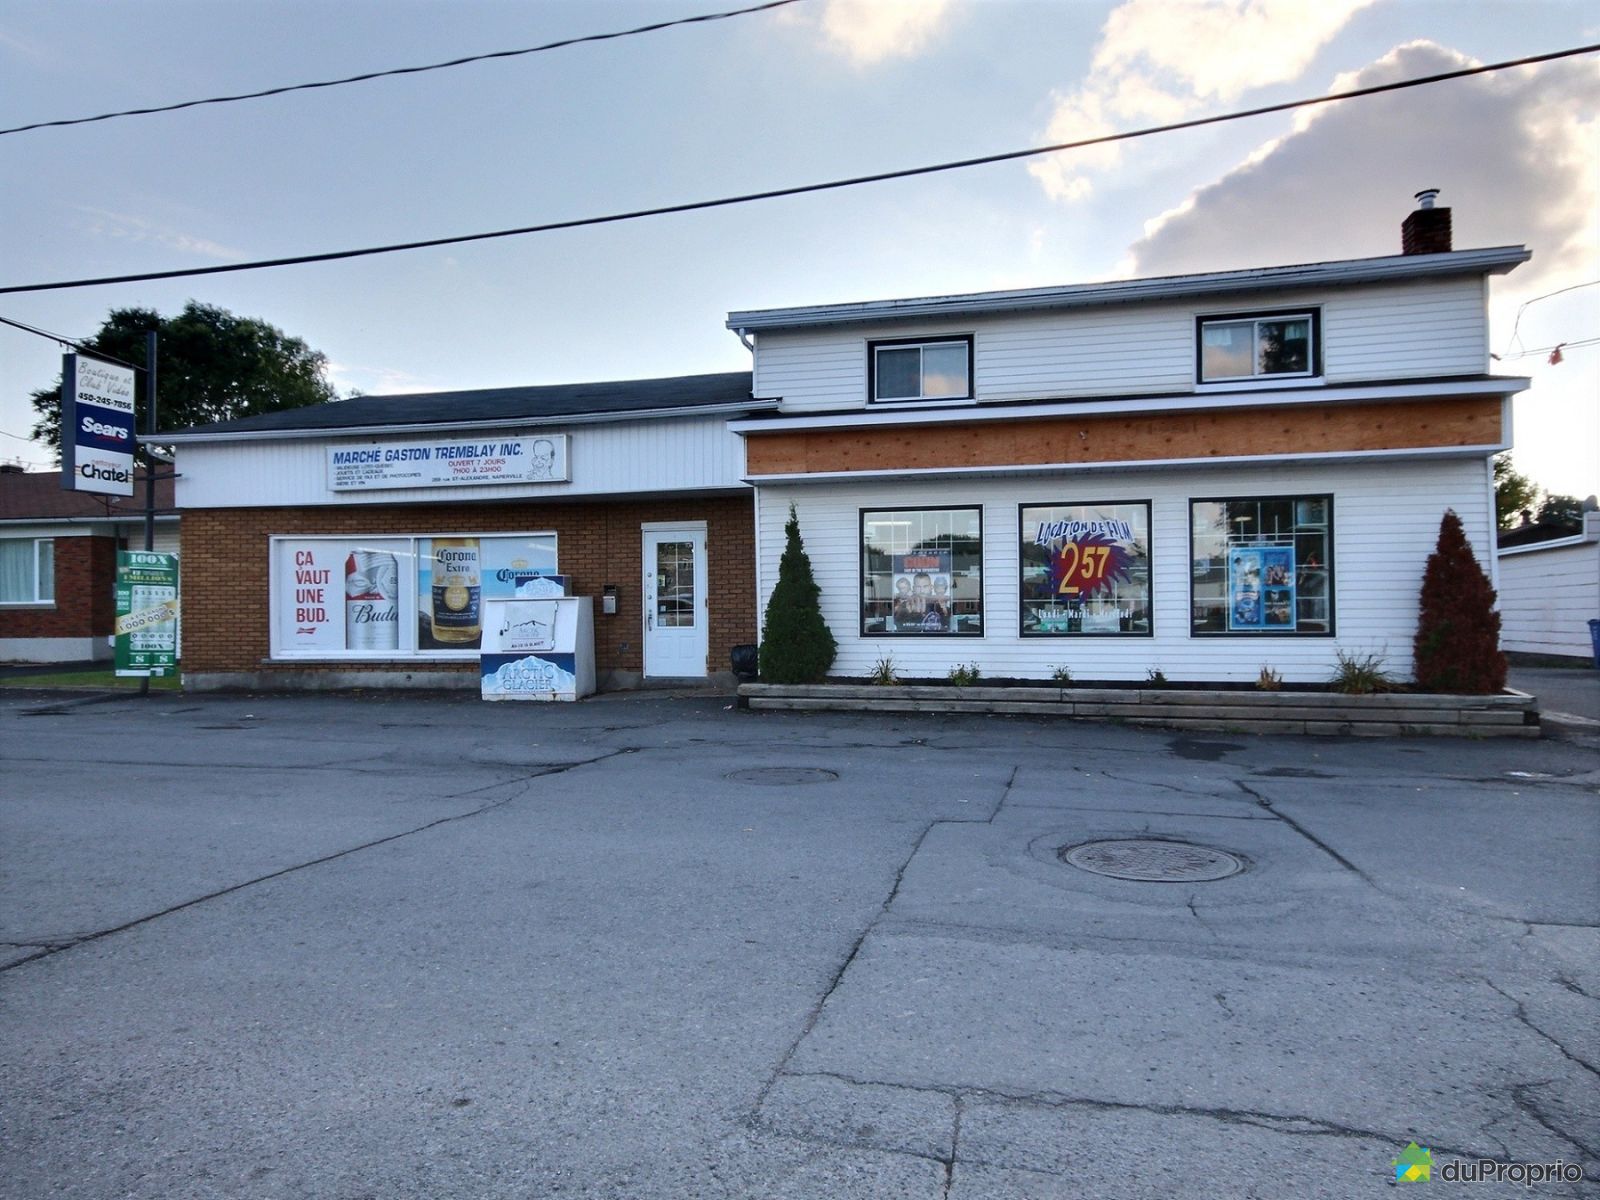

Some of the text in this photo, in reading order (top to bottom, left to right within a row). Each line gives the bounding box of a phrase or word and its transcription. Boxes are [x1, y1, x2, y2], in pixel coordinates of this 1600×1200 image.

[78, 392, 132, 410] 450-245-7856
[81, 416, 128, 439] Sears
[333, 443, 523, 464] MARCHÉ GASTON TREMBLAY INC.
[483, 458, 506, 466] JOURS
[81, 463, 128, 483] Chatel
[1036, 520, 1134, 545] LOCATION DE FILM
[295, 551, 314, 570] ÇA
[295, 570, 330, 584] VAUT
[296, 589, 325, 603] UNE
[296, 607, 330, 622] BUD.
[502, 664, 554, 680] ARCTIC
[503, 679, 553, 690] GLACIER
